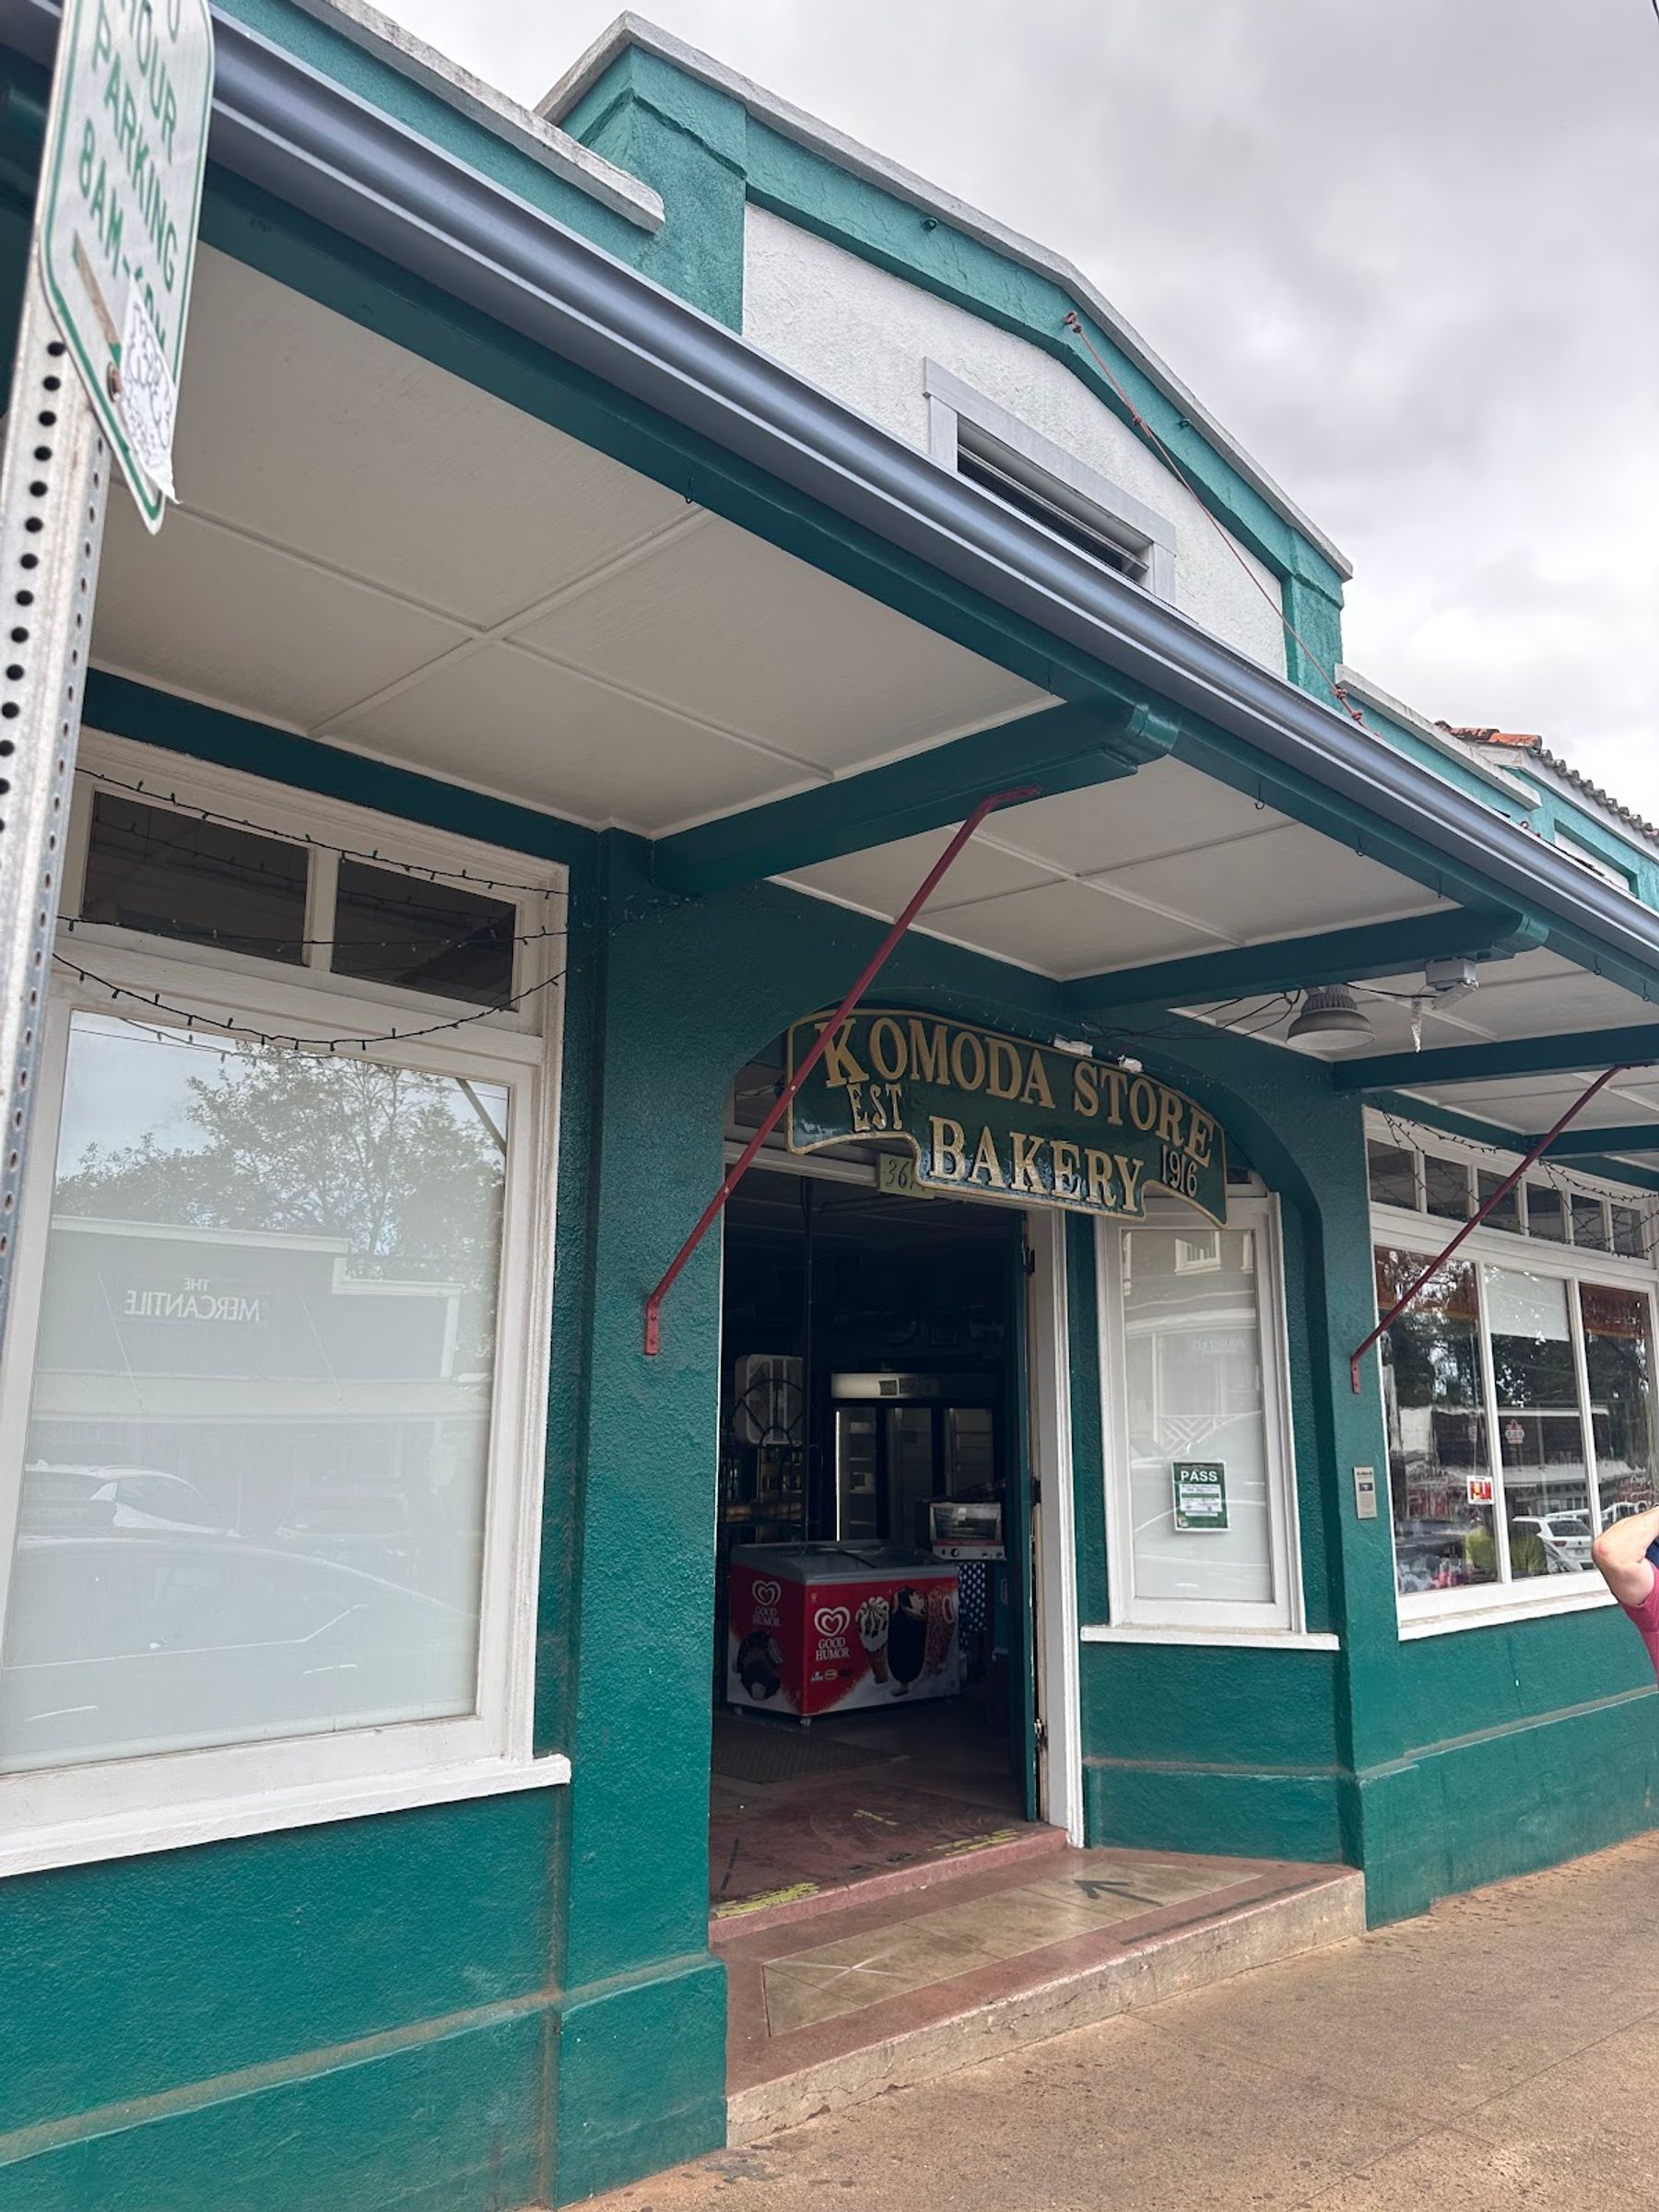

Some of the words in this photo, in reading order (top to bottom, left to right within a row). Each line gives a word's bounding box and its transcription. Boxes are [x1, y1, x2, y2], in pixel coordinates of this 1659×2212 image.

[92, 0, 178, 292] PARKING
[815, 1018, 1056, 1109] KOMODA
[1073, 1061, 1214, 1168] STORE
[846, 1082, 904, 1133] EST
[928, 1115, 1144, 1213] BAKERY
[1160, 1144, 1199, 1198] 1916
[1181, 1470, 1218, 1482] PASS
[816, 1647, 850, 1661] HUMOR
[818, 1637, 845, 1650] GOOD
